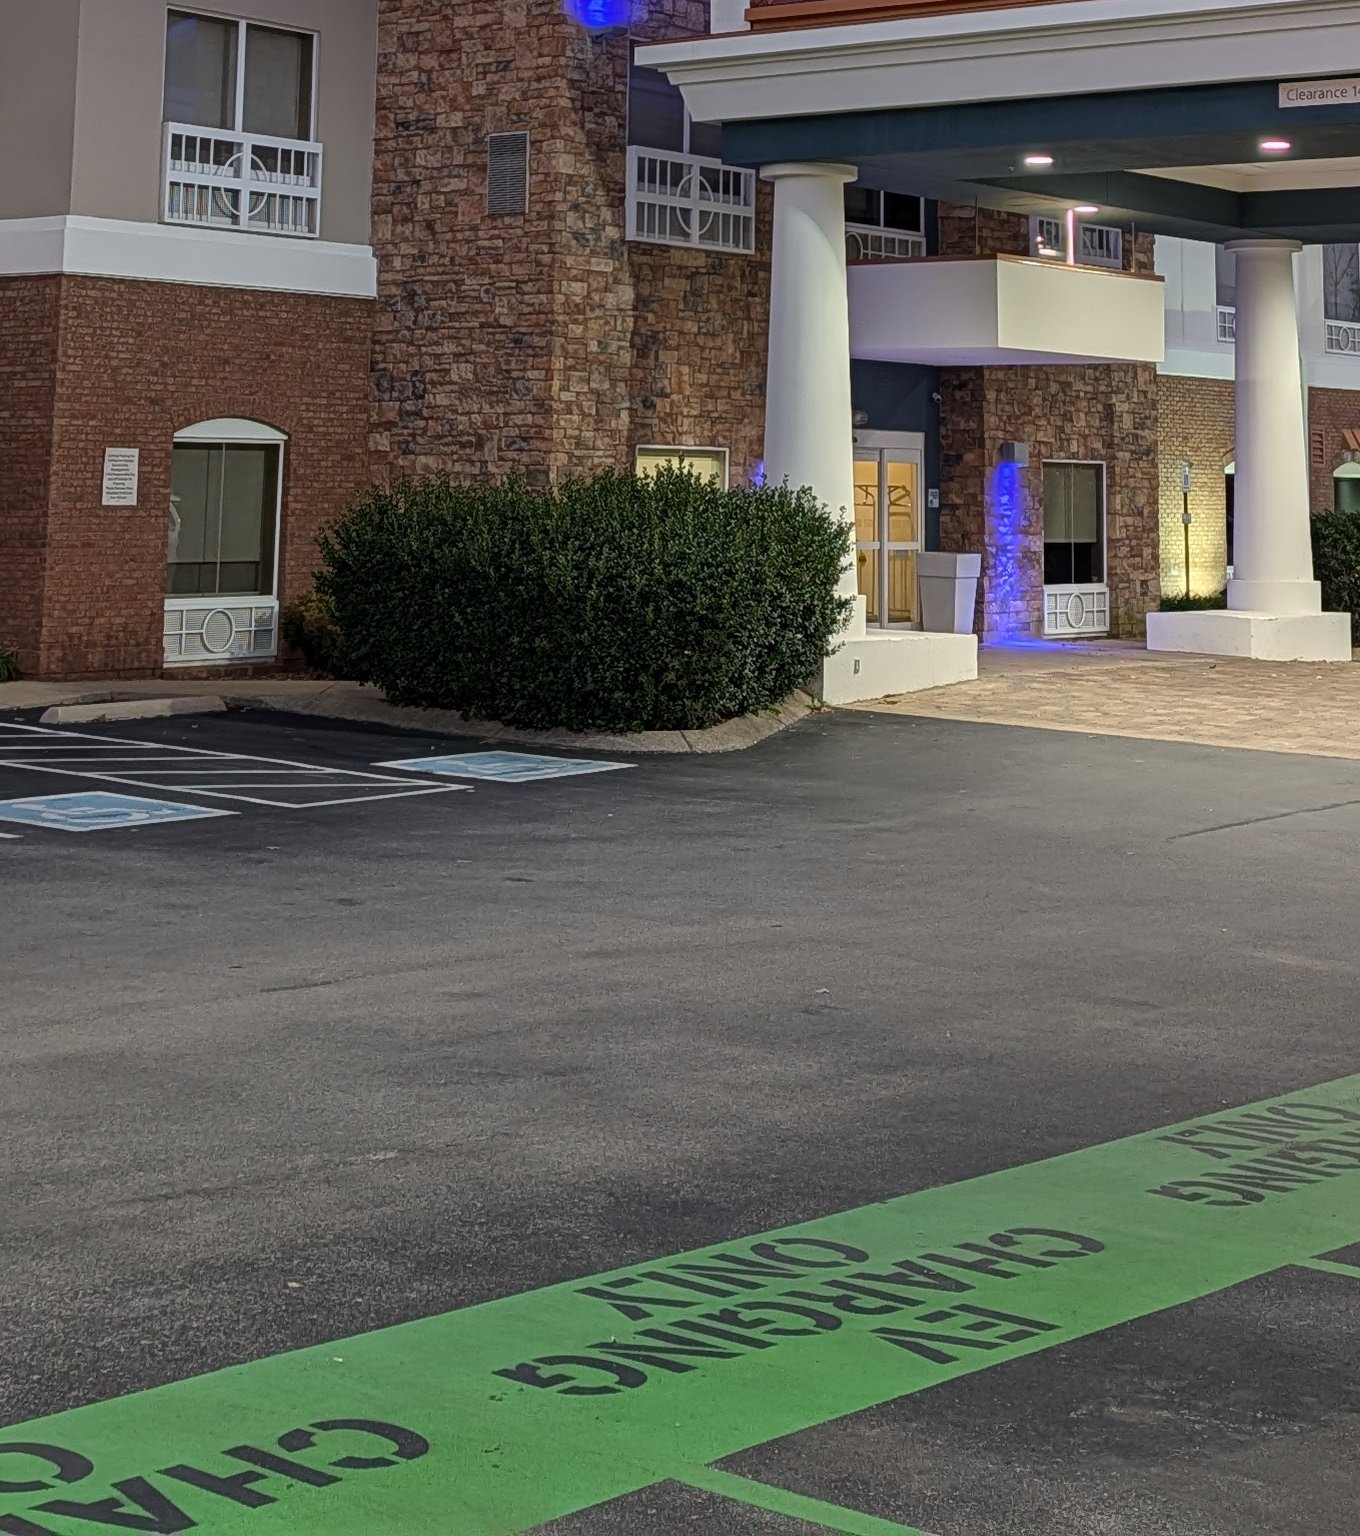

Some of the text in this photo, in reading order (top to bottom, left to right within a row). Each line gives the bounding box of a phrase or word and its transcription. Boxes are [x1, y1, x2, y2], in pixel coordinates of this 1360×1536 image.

[1286, 86, 1348, 101] Clearance
[492, 1227, 1105, 1395] CHARGING
[574, 1238, 869, 1321] ONLY
[869, 1303, 1061, 1364] EV
